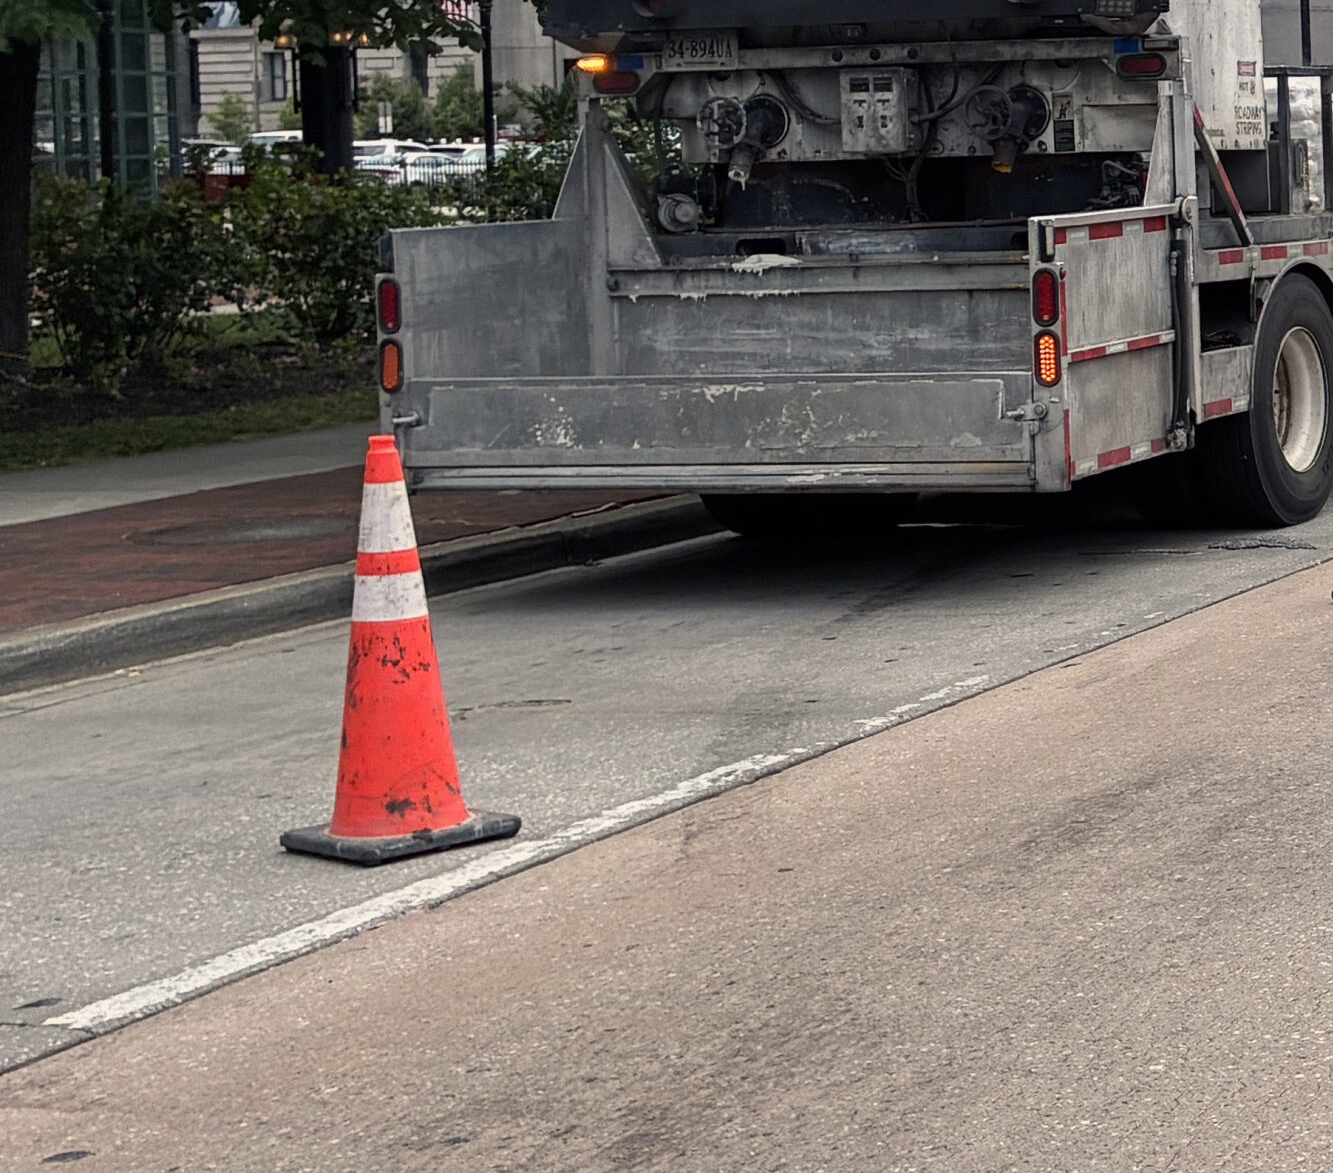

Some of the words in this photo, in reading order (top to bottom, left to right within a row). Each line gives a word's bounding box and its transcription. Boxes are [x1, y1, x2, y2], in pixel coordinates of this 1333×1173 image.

[667, 39, 732, 59] 34-894UA
[1233, 105, 1264, 120] ROADWAY
[1235, 121, 1262, 135] STRIPING
